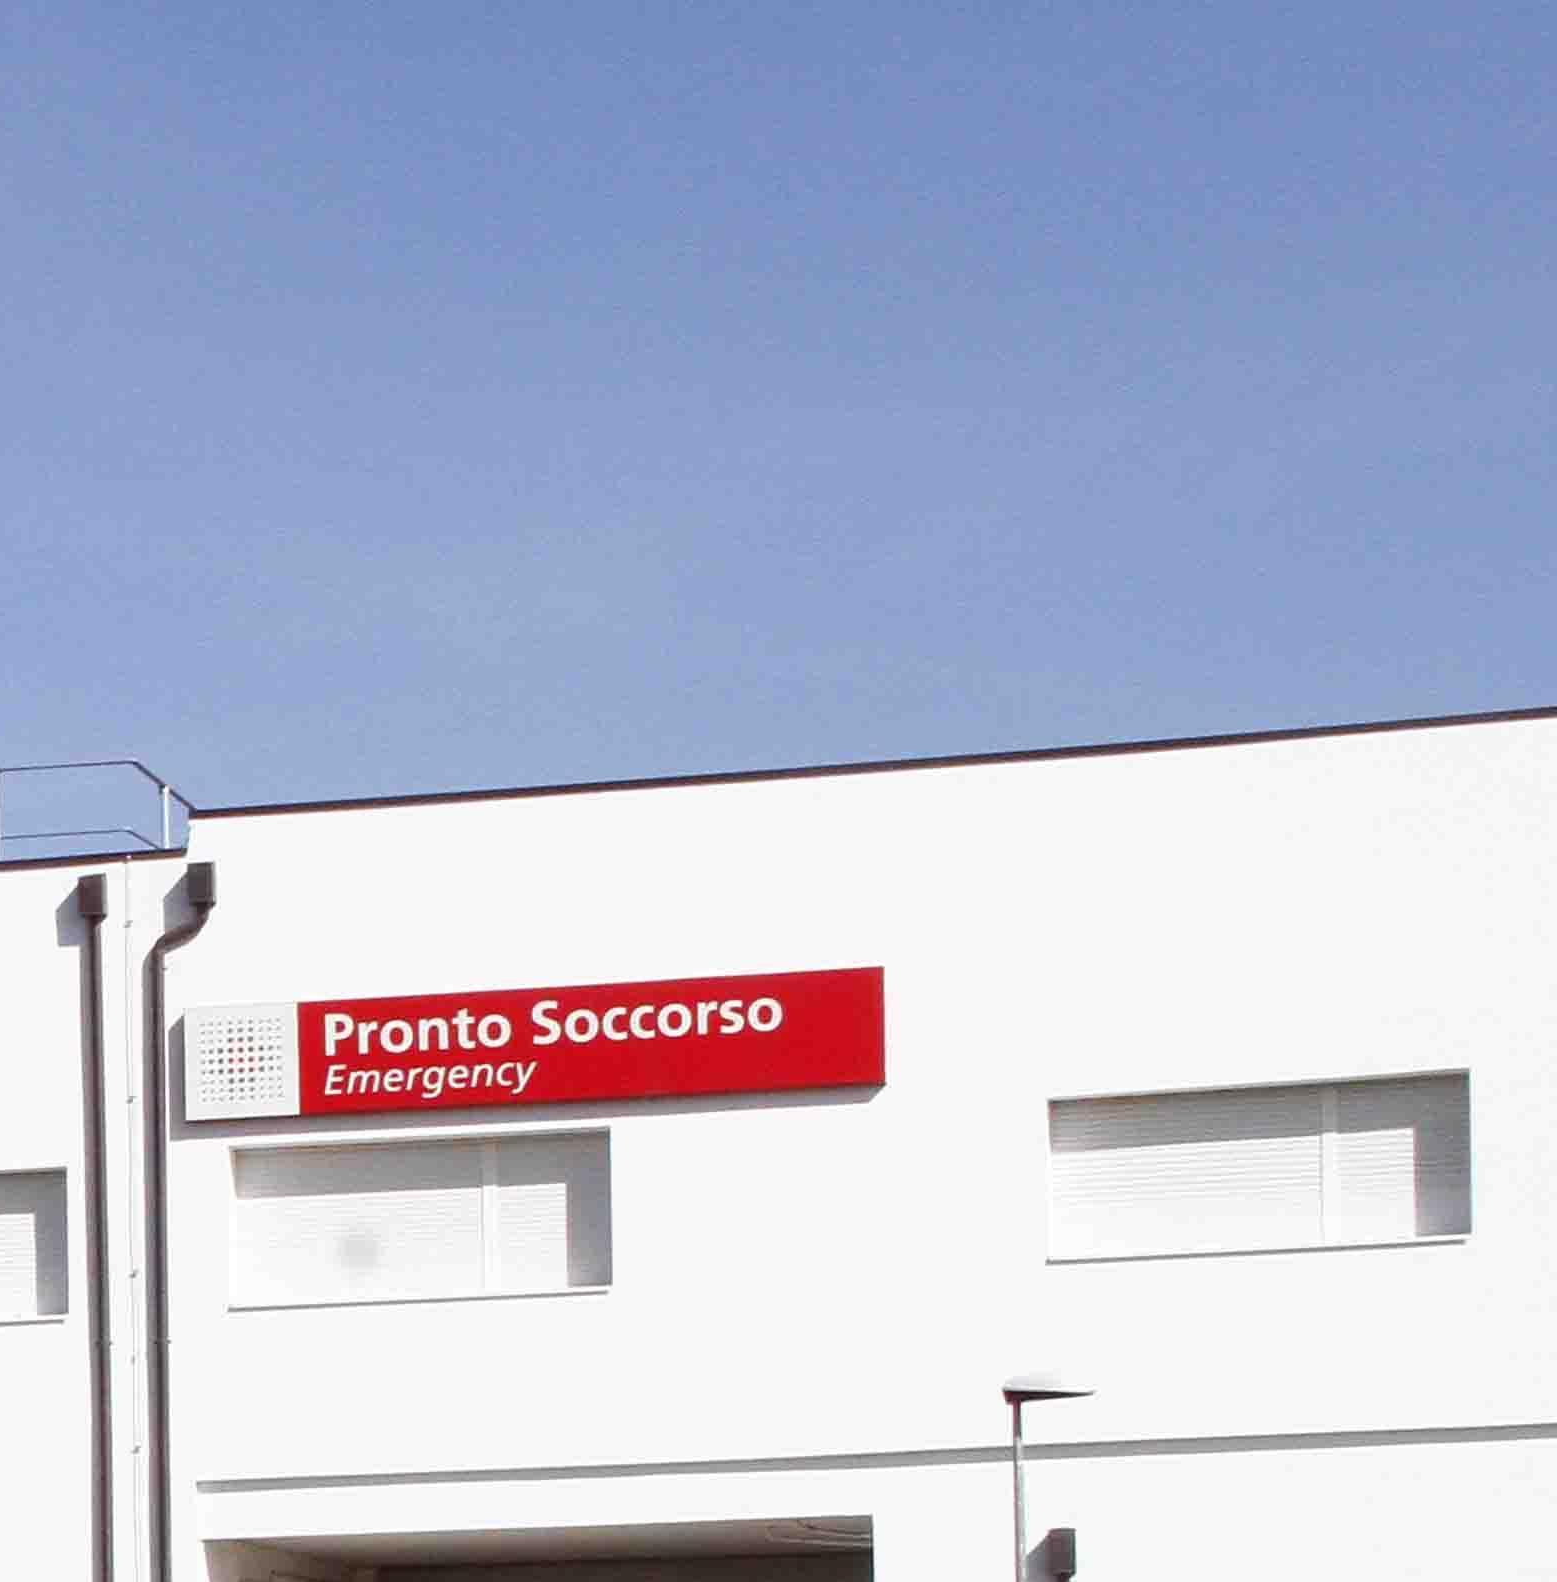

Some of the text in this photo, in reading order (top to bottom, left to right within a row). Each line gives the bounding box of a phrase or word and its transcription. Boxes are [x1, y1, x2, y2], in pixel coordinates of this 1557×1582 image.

[323, 997, 783, 1057] Pronto Soccorso
[323, 1062, 537, 1099] Emergency
